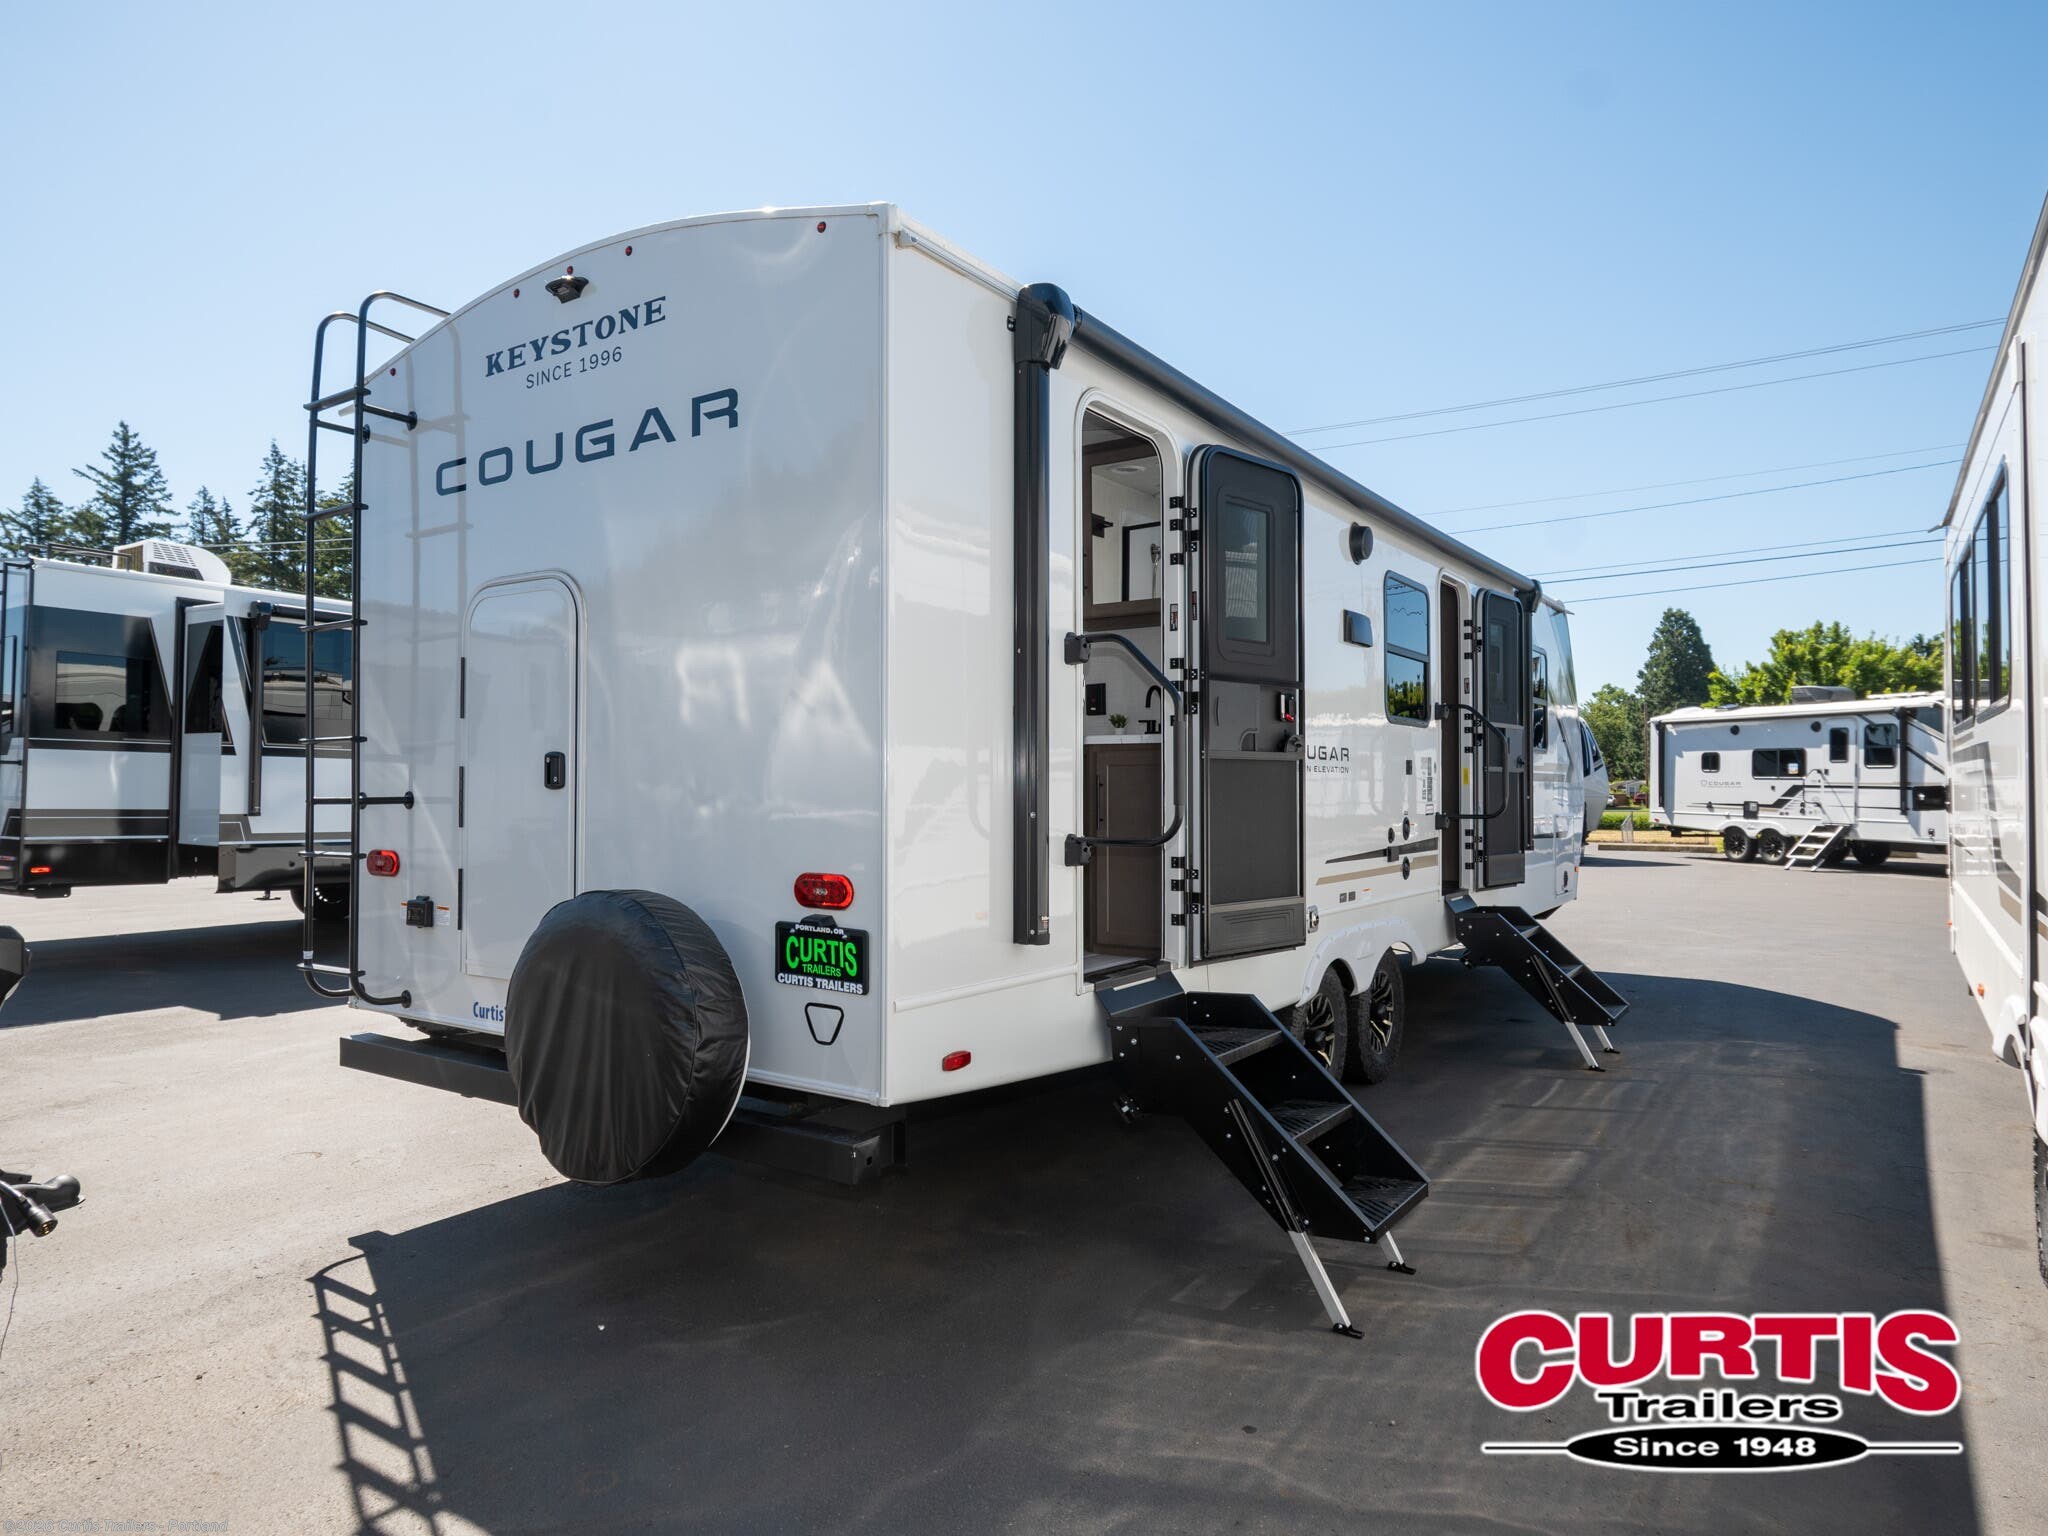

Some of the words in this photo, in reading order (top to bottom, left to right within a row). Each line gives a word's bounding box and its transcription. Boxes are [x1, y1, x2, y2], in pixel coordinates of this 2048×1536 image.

[485, 296, 666, 377] KEYSTONE
[526, 361, 572, 389] SINCE
[579, 346, 622, 373] 1996
[436, 388, 738, 496] COUGAR
[1306, 745, 1350, 761] UGAR
[1314, 765, 1349, 774] ELEVATION
[786, 936, 858, 977] CURTIS
[802, 964, 841, 977] TRAILERS
[777, 973, 814, 987] CURTIS
[815, 978, 863, 995] TRAILERS
[473, 1001, 506, 1021] Curtis
